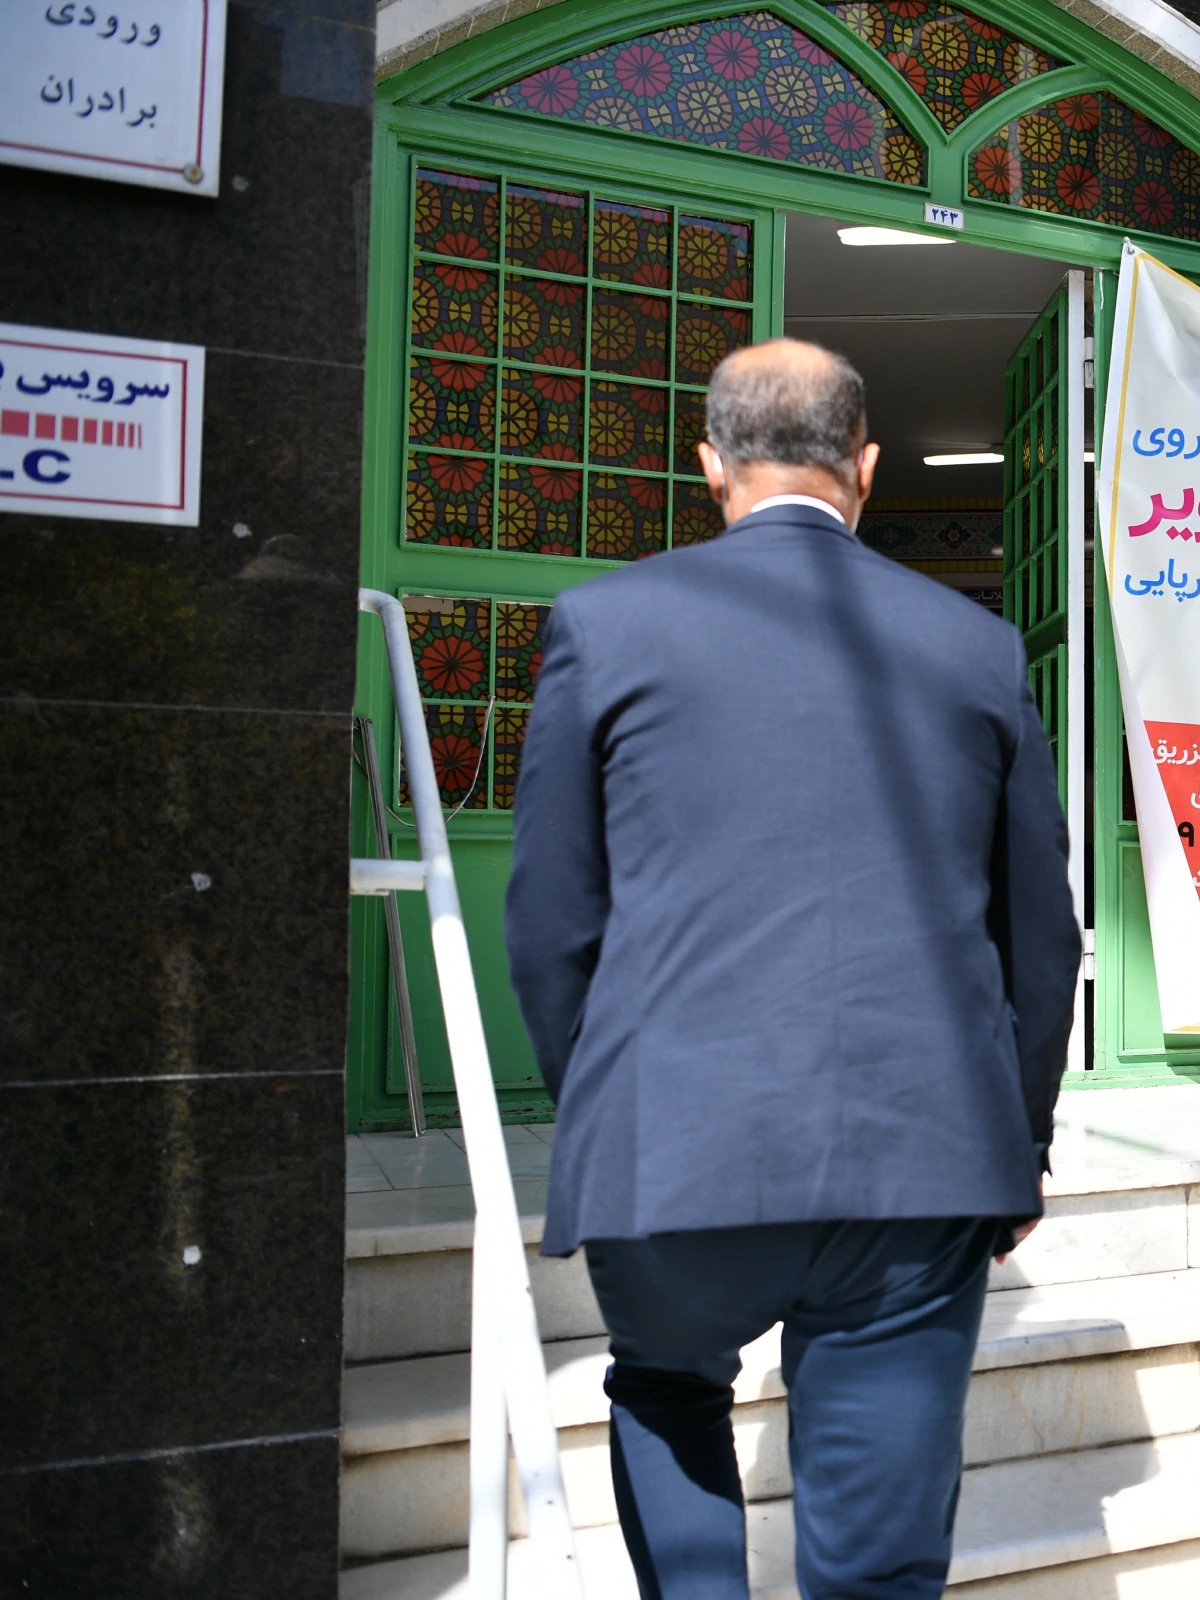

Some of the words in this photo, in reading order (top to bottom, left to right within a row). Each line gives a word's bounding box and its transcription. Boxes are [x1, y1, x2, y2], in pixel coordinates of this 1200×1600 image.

[45, 2, 161, 47] ورودی
[40, 74, 158, 128] برادران
[931, 207, 959, 226] ۲۴۳
[16, 368, 170, 405] سرویس
